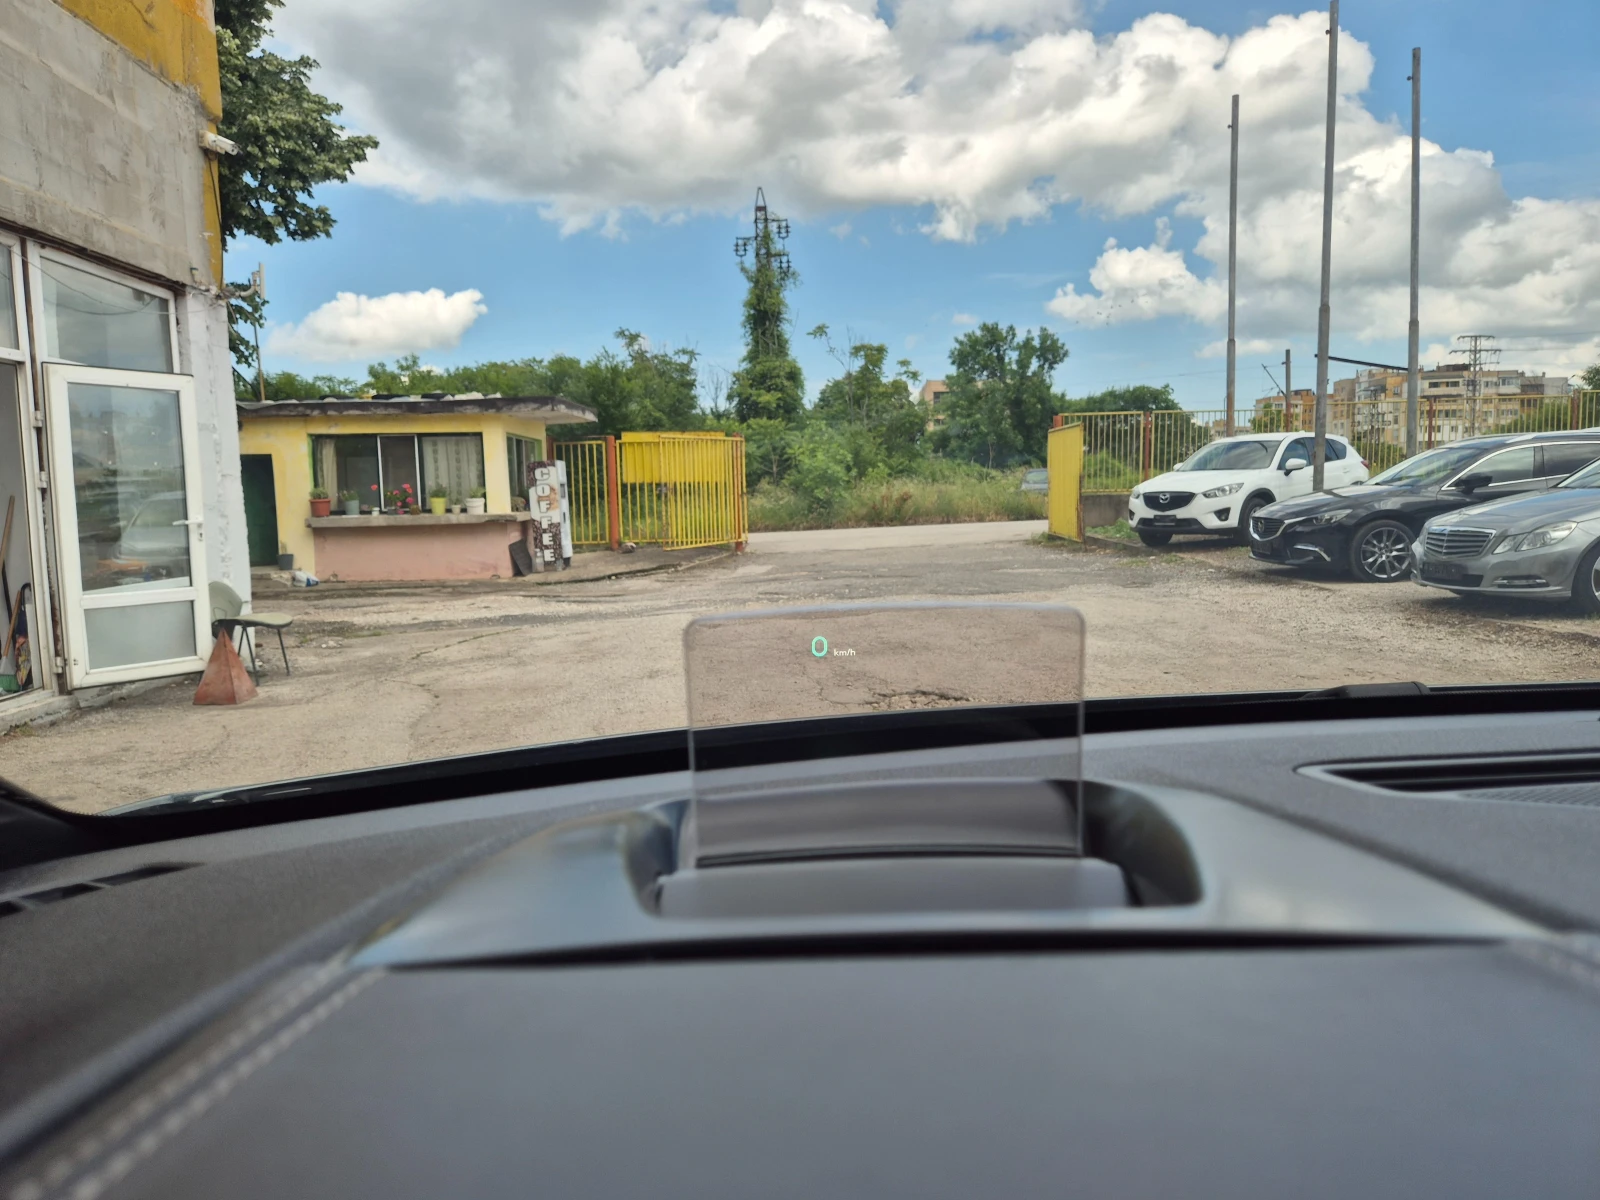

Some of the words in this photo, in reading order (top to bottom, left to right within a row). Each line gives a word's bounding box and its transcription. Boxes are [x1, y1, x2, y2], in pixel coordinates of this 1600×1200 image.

[534, 467, 556, 563] COFFEE
[811, 635, 828, 657] 0
[833, 648, 856, 656] km/h
